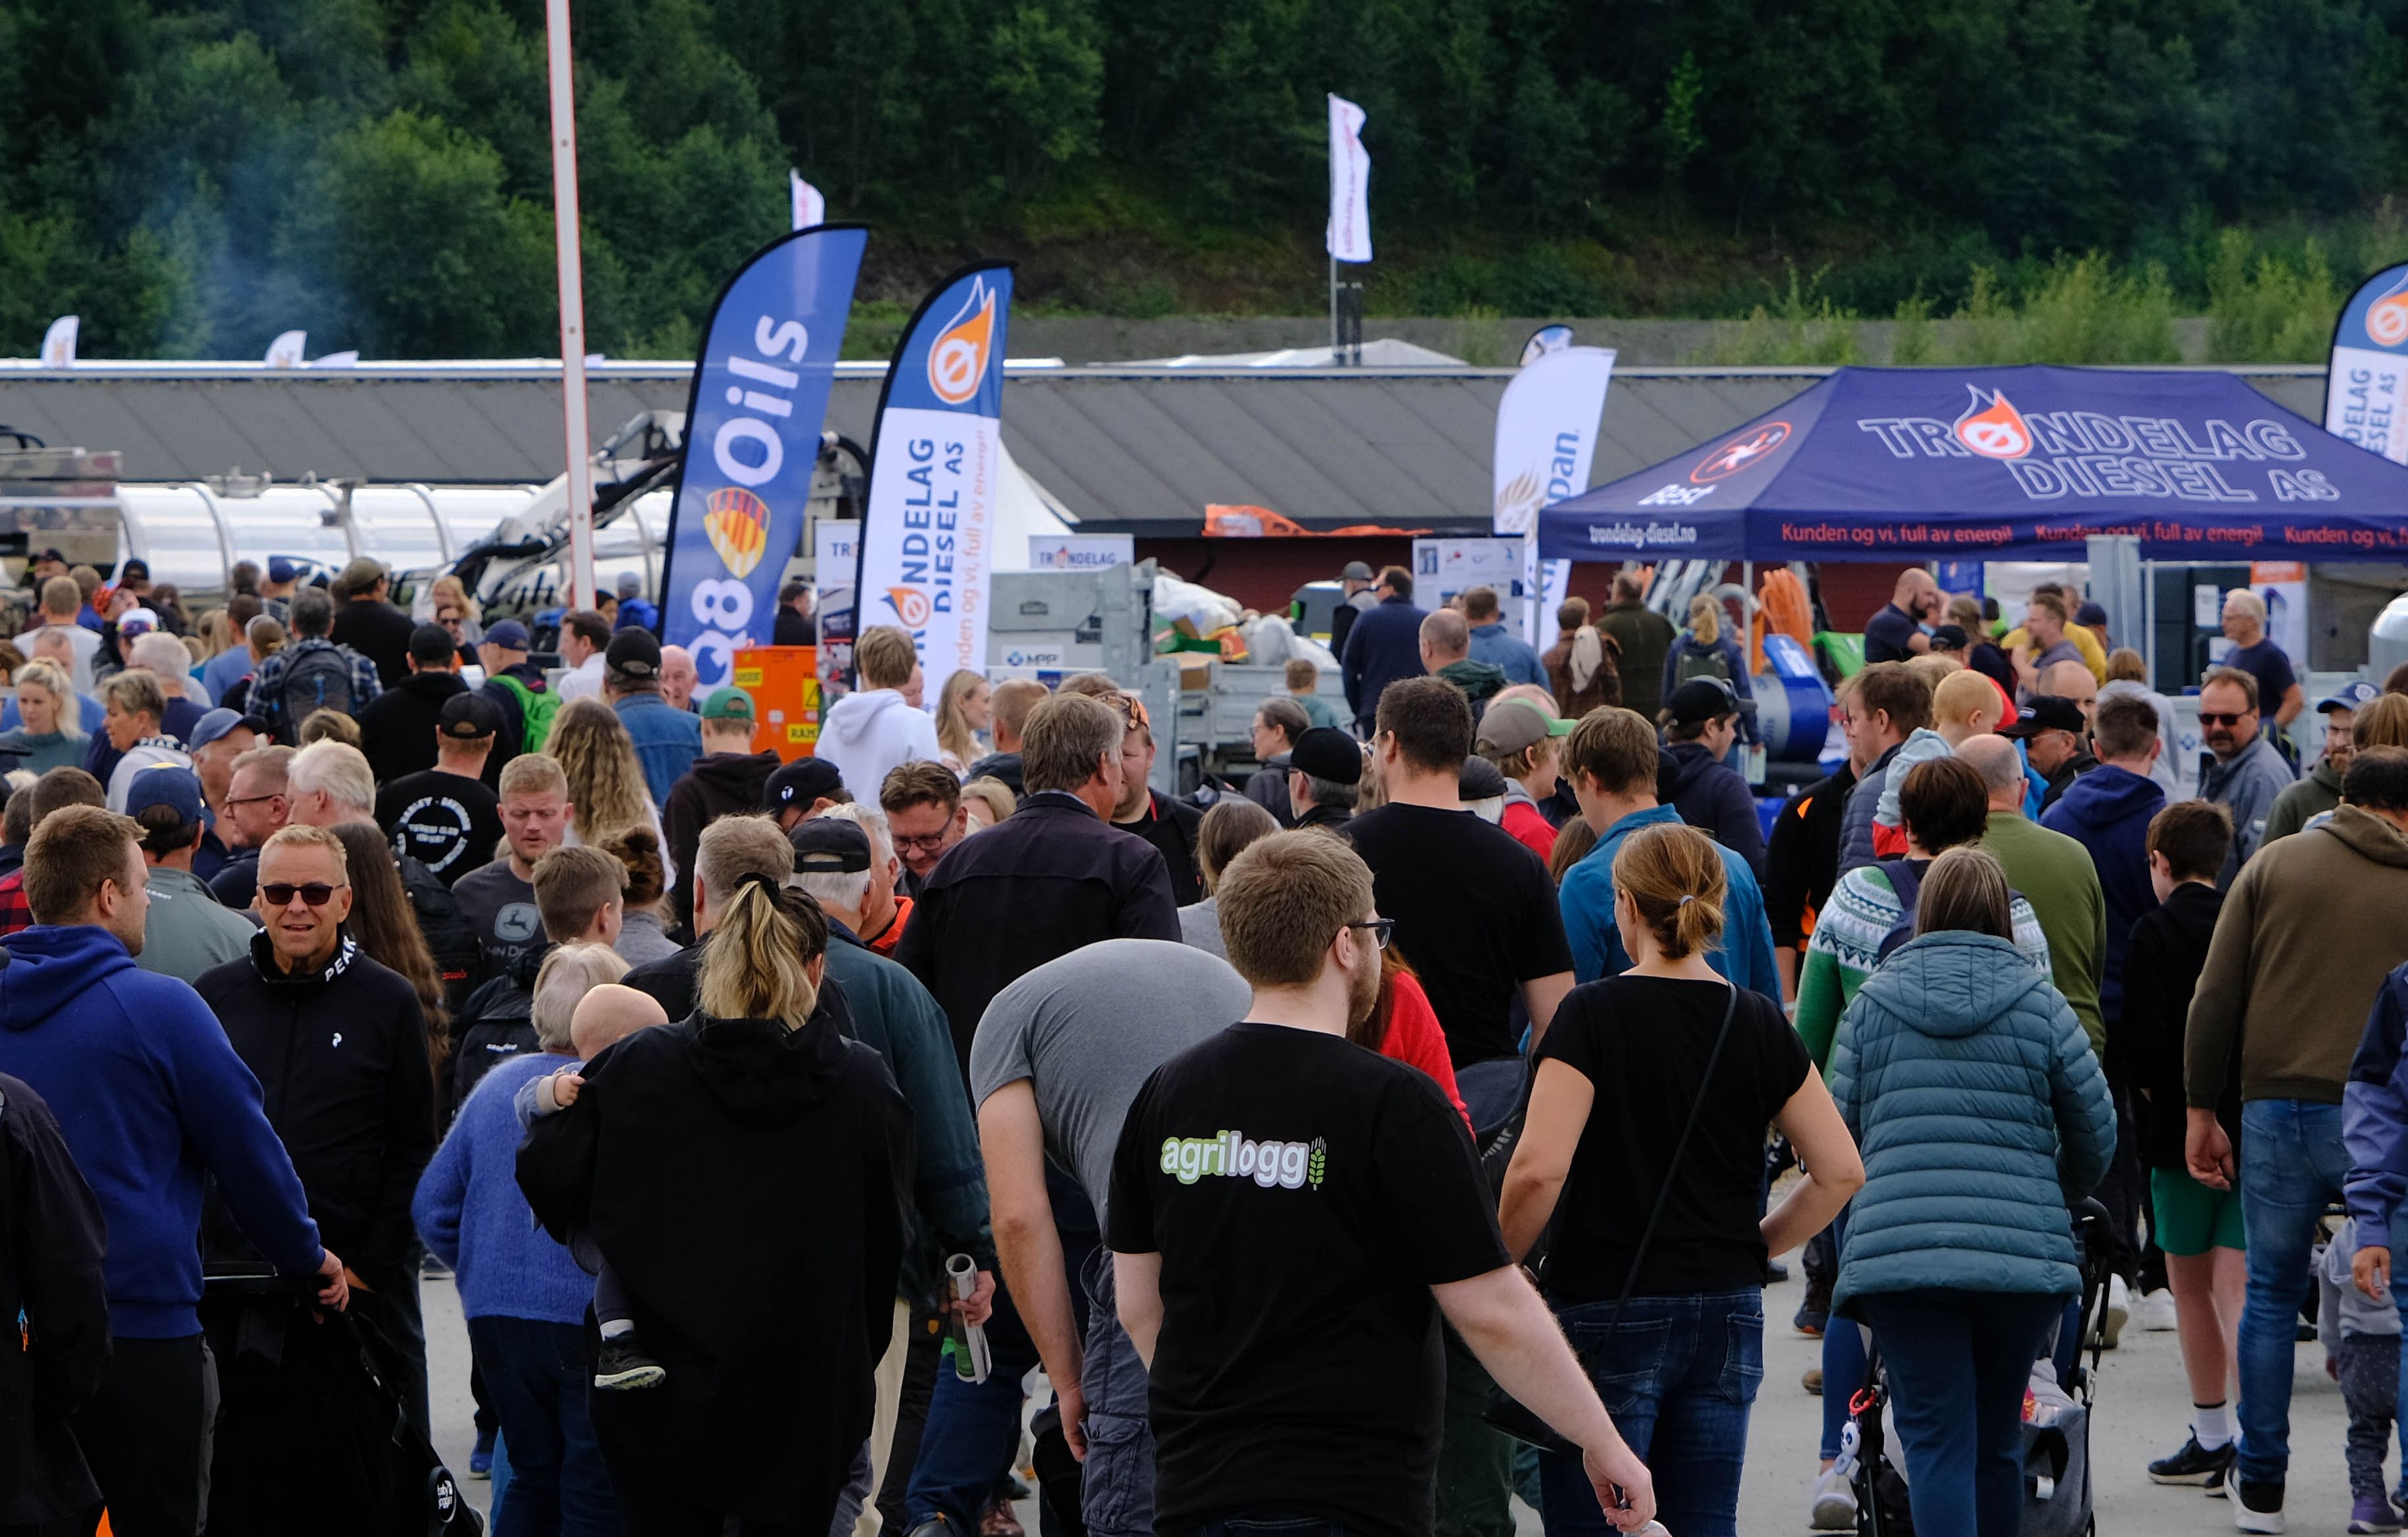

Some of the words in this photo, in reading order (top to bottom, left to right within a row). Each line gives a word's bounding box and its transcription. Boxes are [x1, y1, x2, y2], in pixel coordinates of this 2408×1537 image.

[713, 315, 809, 486] Oils
[2377, 372, 2397, 395] AS
[1857, 409, 2307, 461] TRØNDELAG
[945, 441, 964, 476] AS
[2004, 458, 2258, 502] DIESEL
[2267, 469, 2341, 501] AS
[969, 500, 984, 524] av
[933, 490, 959, 612] DIESEL
[963, 526, 983, 560] full
[1781, 524, 1847, 541] Kunden
[1851, 528, 1874, 545] og
[1877, 527, 1897, 543] vi,
[1900, 524, 1927, 541] full
[1931, 528, 1950, 542] av
[1953, 525, 2012, 545] energi!
[2154, 523, 2181, 540] full
[2183, 528, 2204, 541] av
[2206, 525, 2264, 546] energi!
[2284, 525, 2348, 543] Kunden
[2351, 529, 2375, 548] og
[963, 562, 981, 585] vi,
[960, 588, 982, 617] og
[690, 578, 754, 700] Q8
[955, 619, 975, 669] nden
[325, 934, 358, 982] PEAK
[1162, 1132, 1308, 1187] agrilogg
